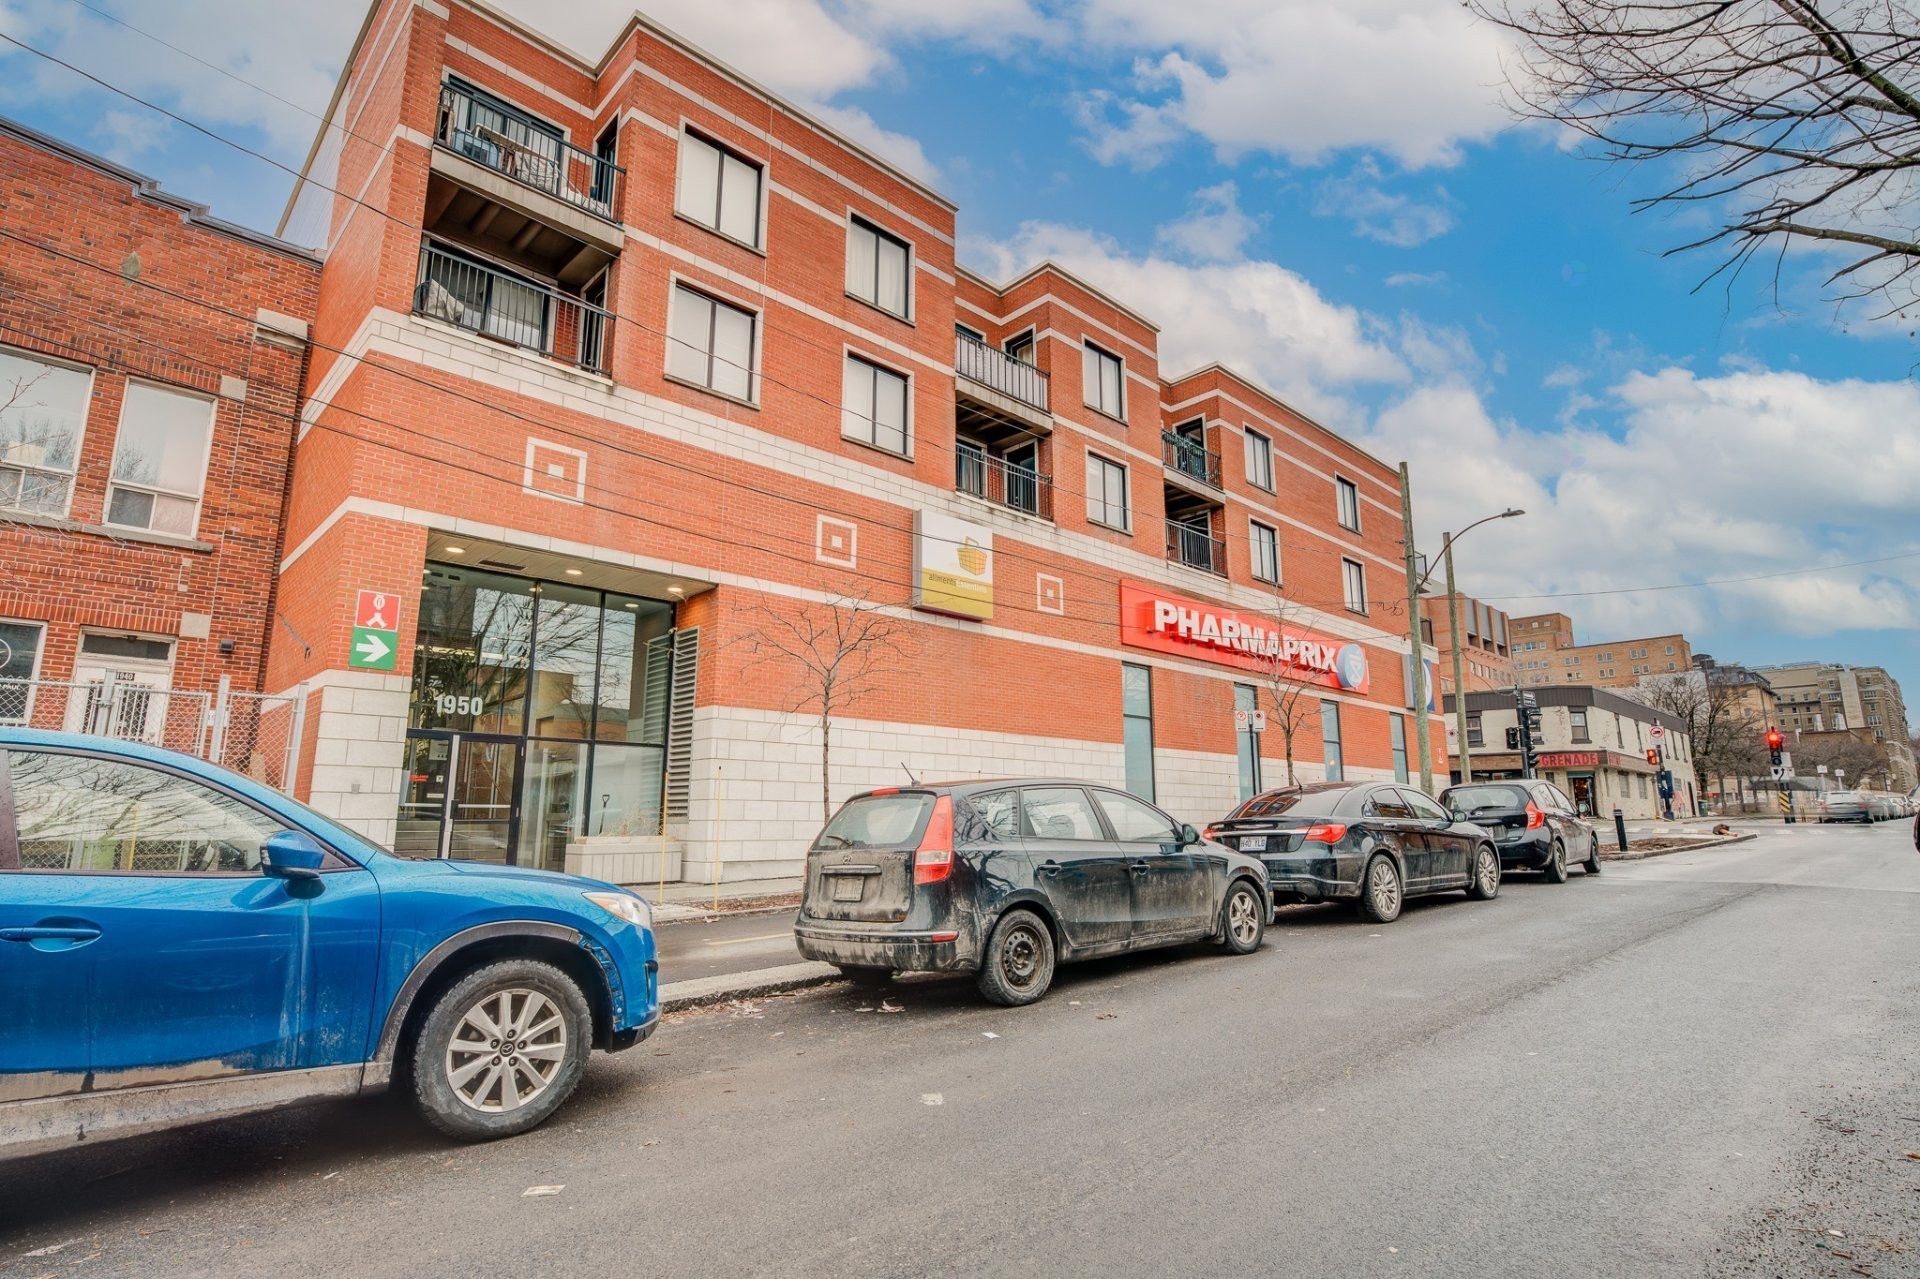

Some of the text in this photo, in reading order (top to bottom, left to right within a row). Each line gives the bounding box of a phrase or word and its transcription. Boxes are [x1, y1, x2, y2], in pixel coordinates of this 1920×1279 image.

[1153, 599, 1339, 673] PHARMAPRIX
[116, 672, 134, 681] 1940
[434, 694, 483, 717] 1950
[1541, 753, 1598, 767] GRENADE
